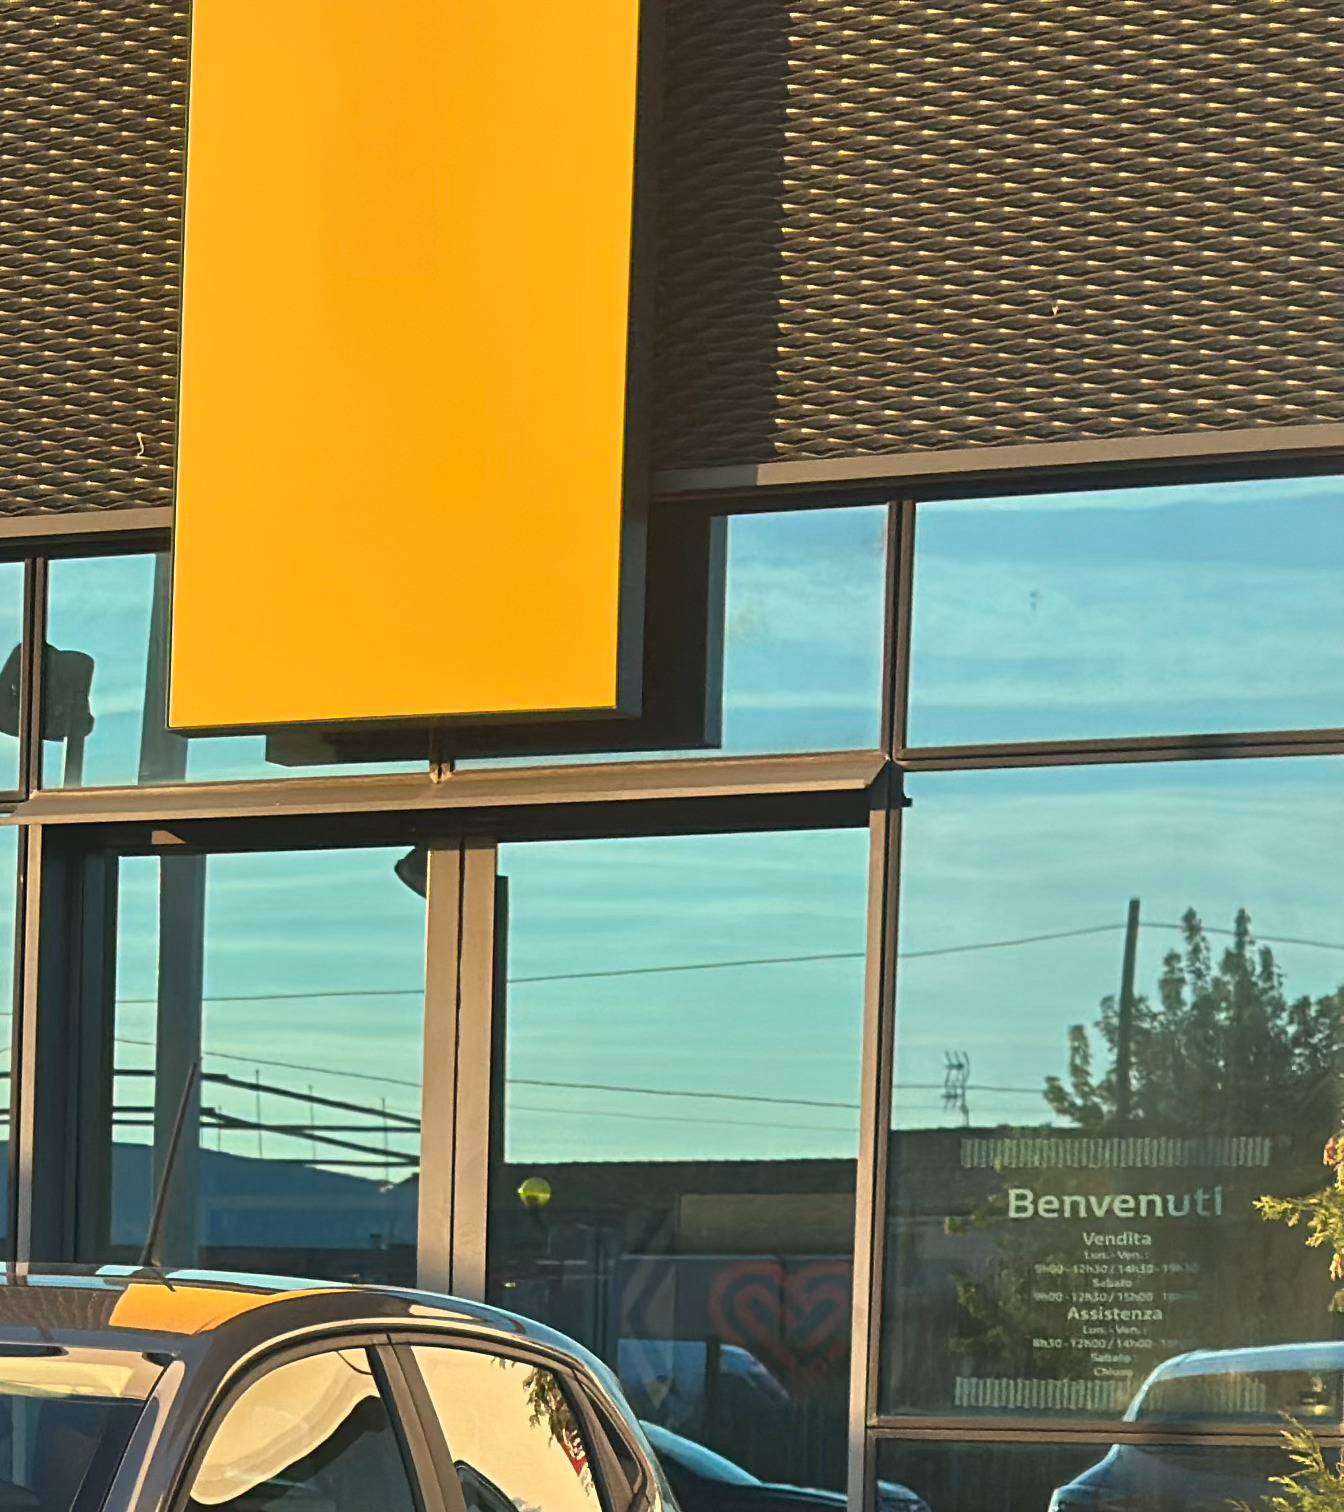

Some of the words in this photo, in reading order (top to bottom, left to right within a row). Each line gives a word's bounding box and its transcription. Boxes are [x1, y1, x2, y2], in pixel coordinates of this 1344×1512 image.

[1008, 1186, 1224, 1219] Benvenuti
[1083, 1232, 1152, 1246] Vendita
[1067, 1306, 1164, 1321] Assistenza
